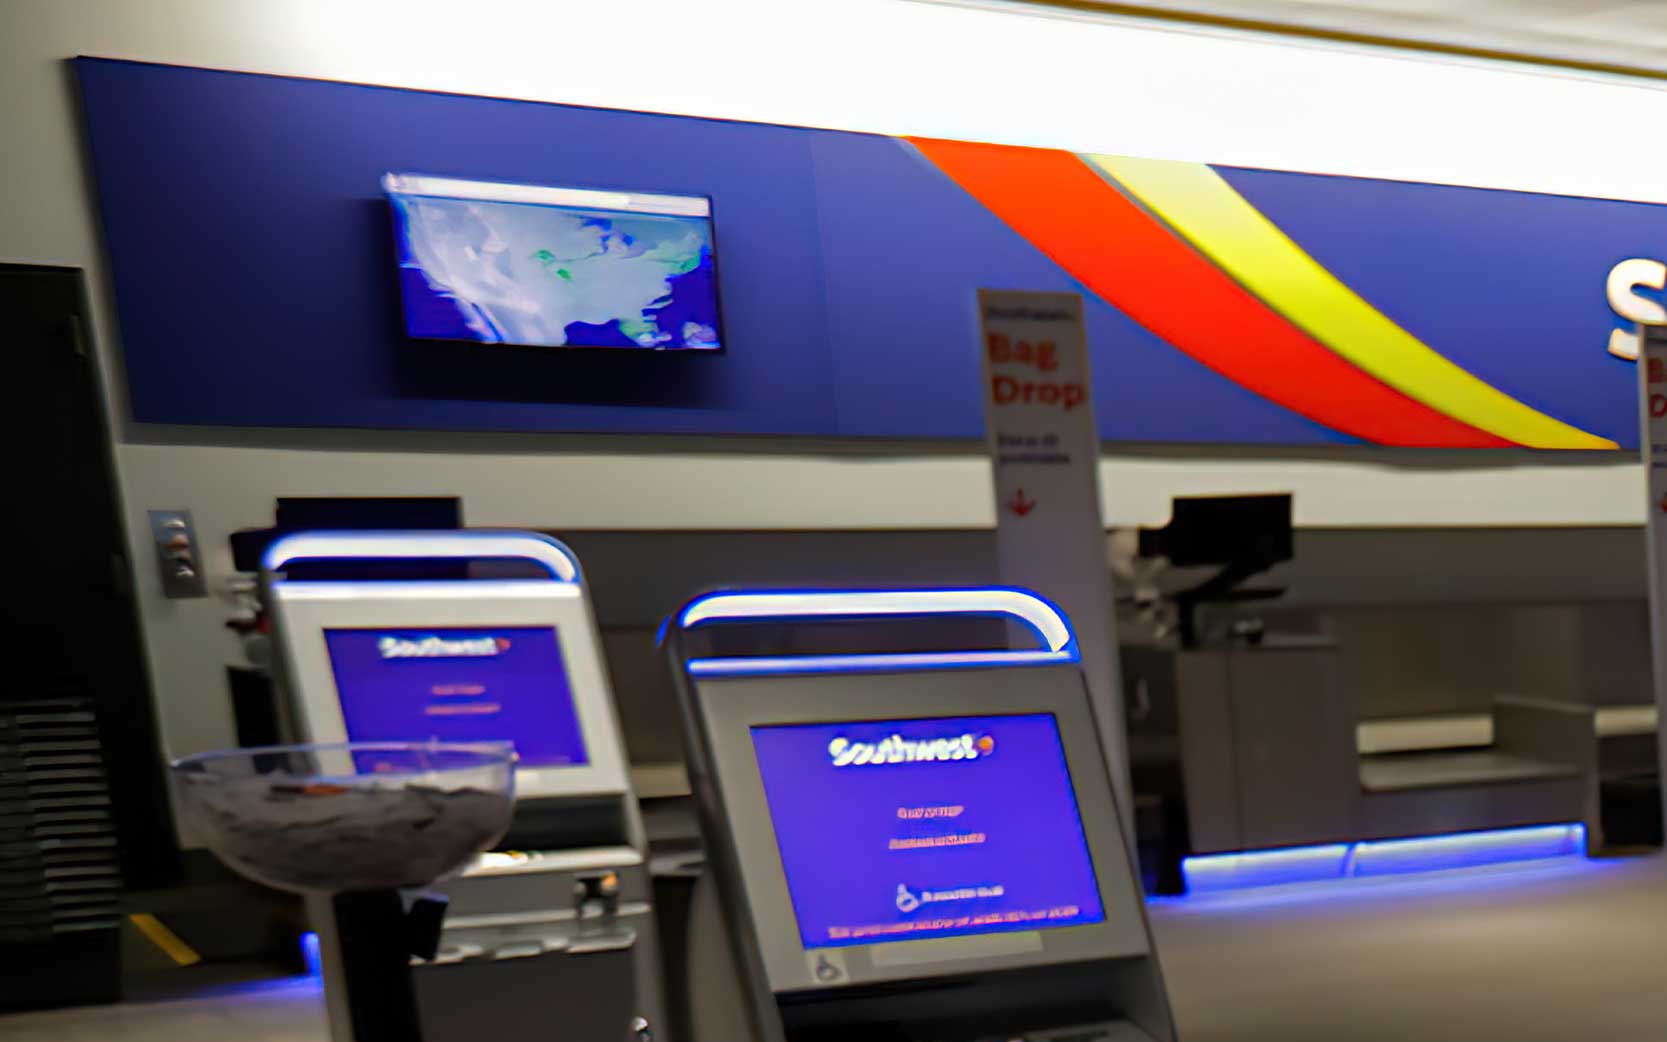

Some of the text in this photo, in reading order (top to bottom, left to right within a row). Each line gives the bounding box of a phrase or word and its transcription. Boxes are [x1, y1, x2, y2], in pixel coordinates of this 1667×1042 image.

[987, 333, 1058, 372] Bag
[991, 376, 1085, 412] Drop
[829, 734, 978, 766] Southwest
